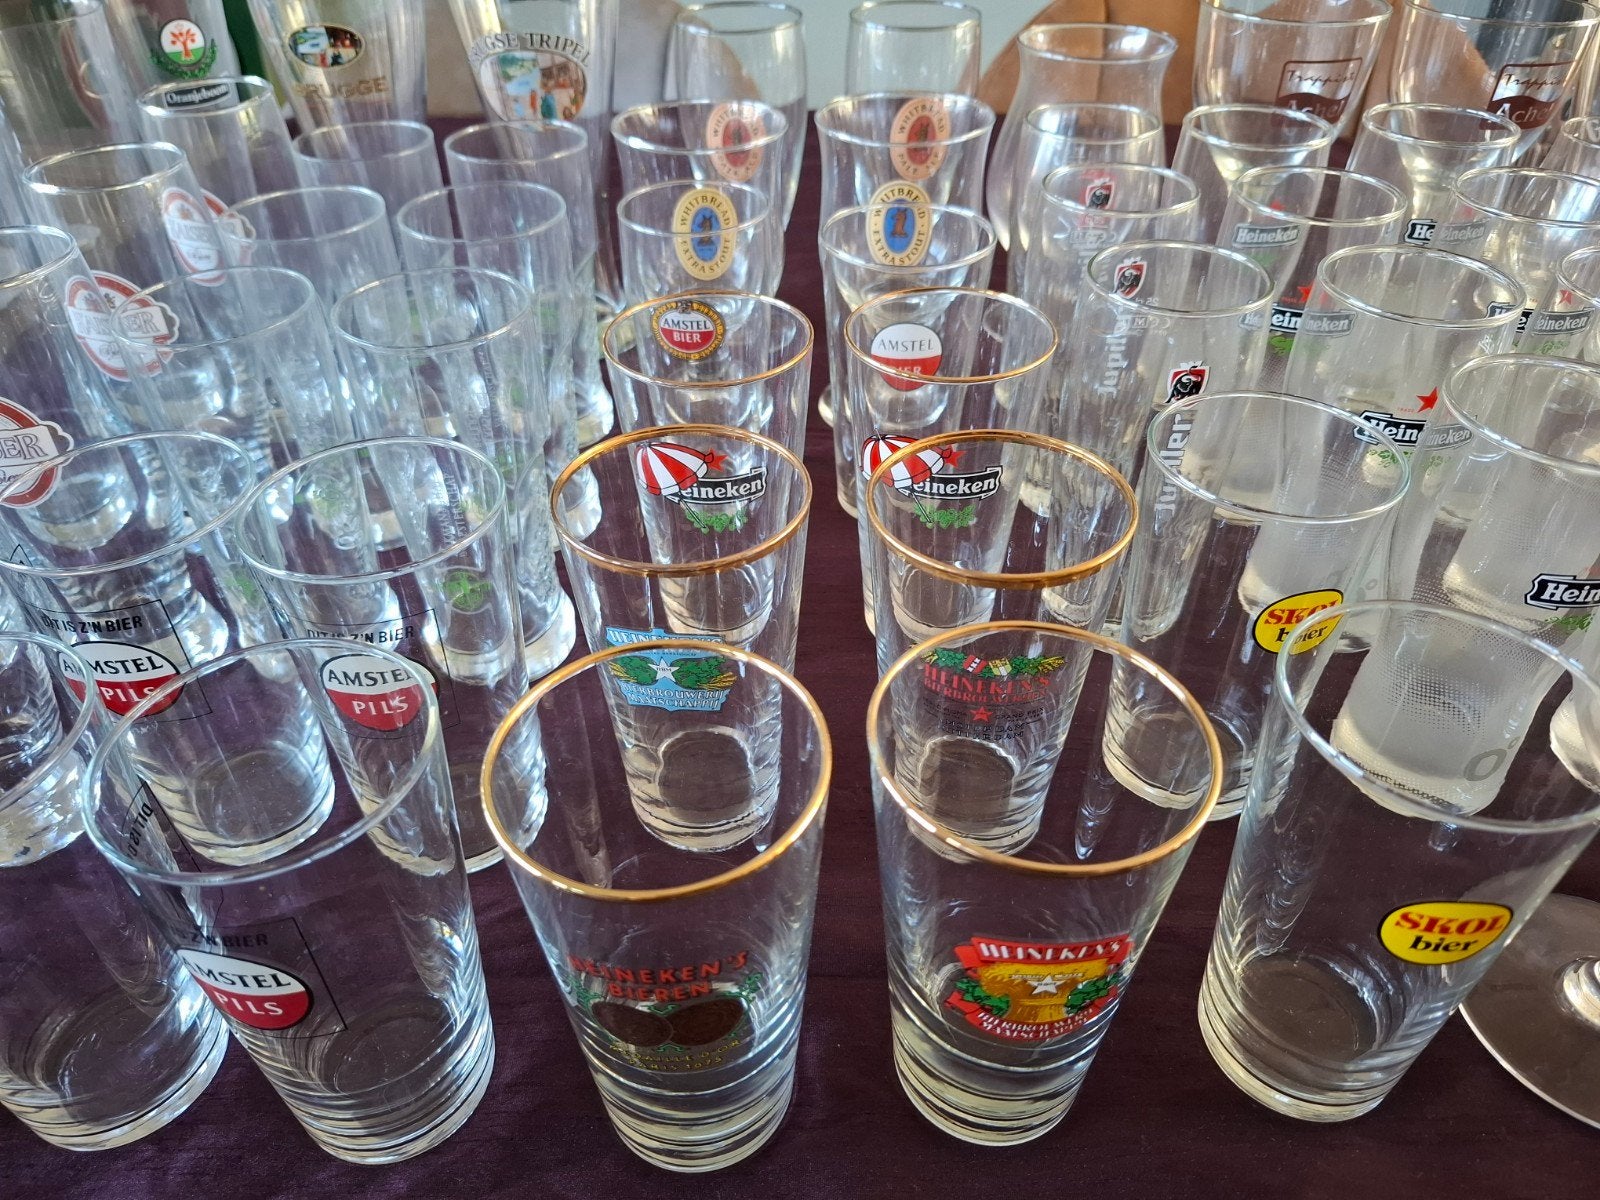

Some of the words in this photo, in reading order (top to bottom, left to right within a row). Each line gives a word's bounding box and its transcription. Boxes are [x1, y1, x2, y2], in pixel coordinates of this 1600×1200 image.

[524, 33, 590, 66] TRIPEL
[680, 195, 731, 227] WHITBREAD
[873, 188, 927, 219] WITBRED
[1235, 228, 1299, 243] Heineken
[662, 318, 711, 331] AMSTEL
[672, 331, 702, 343] BIER
[878, 338, 934, 352] AMSTEL
[679, 479, 763, 499] eineken
[912, 477, 990, 495] eineken
[78, 621, 102, 634] Z'N
[105, 615, 142, 632] BIER
[378, 626, 414, 643] BIER
[100, 686, 156, 702] PILS
[352, 696, 409, 715] PILS
[222, 933, 268, 947] BIER
[1409, 935, 1479, 952] bier
[567, 952, 748, 984] HEINEKEN'S
[608, 982, 713, 1003] BIEREN
[213, 991, 284, 1015] PILS
